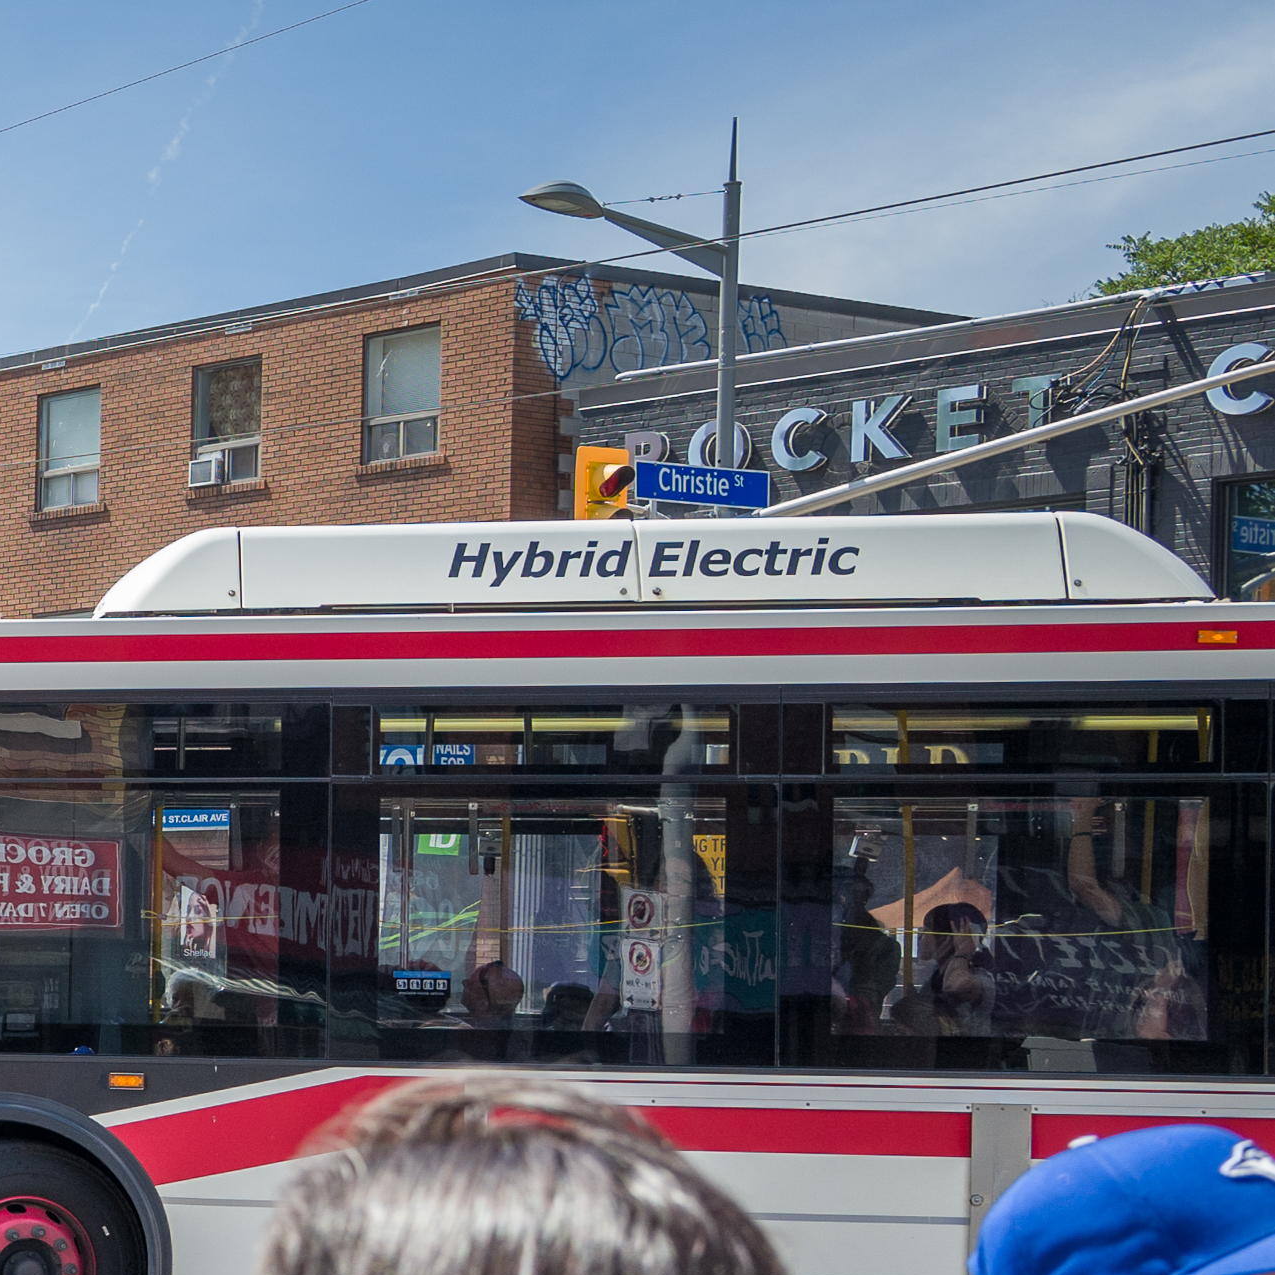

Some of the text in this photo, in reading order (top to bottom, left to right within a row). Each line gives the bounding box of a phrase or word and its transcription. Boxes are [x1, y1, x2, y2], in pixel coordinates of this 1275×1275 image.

[659, 466, 744, 497] Christie St
[448, 537, 860, 587] Hybrid Electric
[168, 814, 209, 824] ST.CLAIR
[209, 813, 229, 823] AVE
